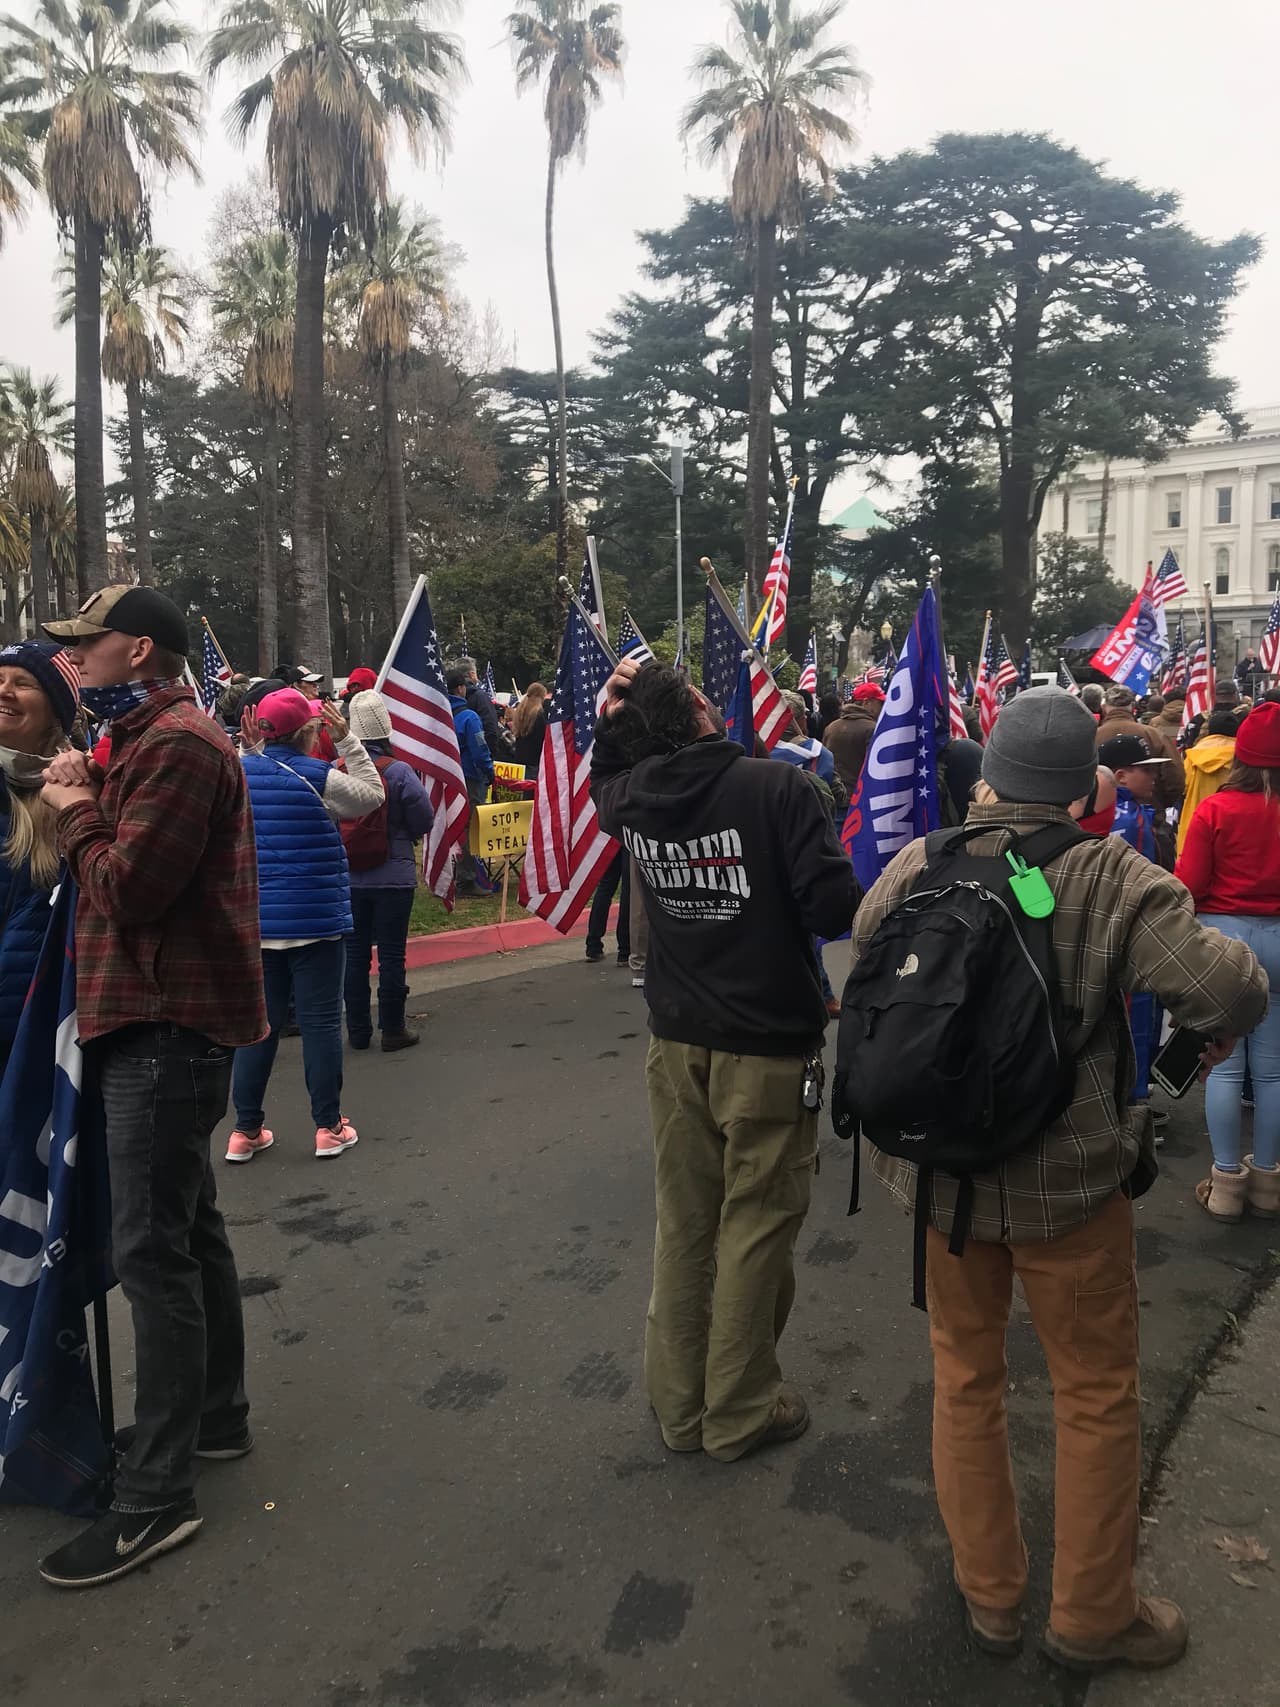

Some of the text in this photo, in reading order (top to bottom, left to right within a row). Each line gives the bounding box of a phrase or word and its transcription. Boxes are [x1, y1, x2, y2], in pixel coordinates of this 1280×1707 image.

[491, 811, 520, 827] STOP
[487, 835, 528, 852] STEAL
[719, 899, 741, 909] 2:3
